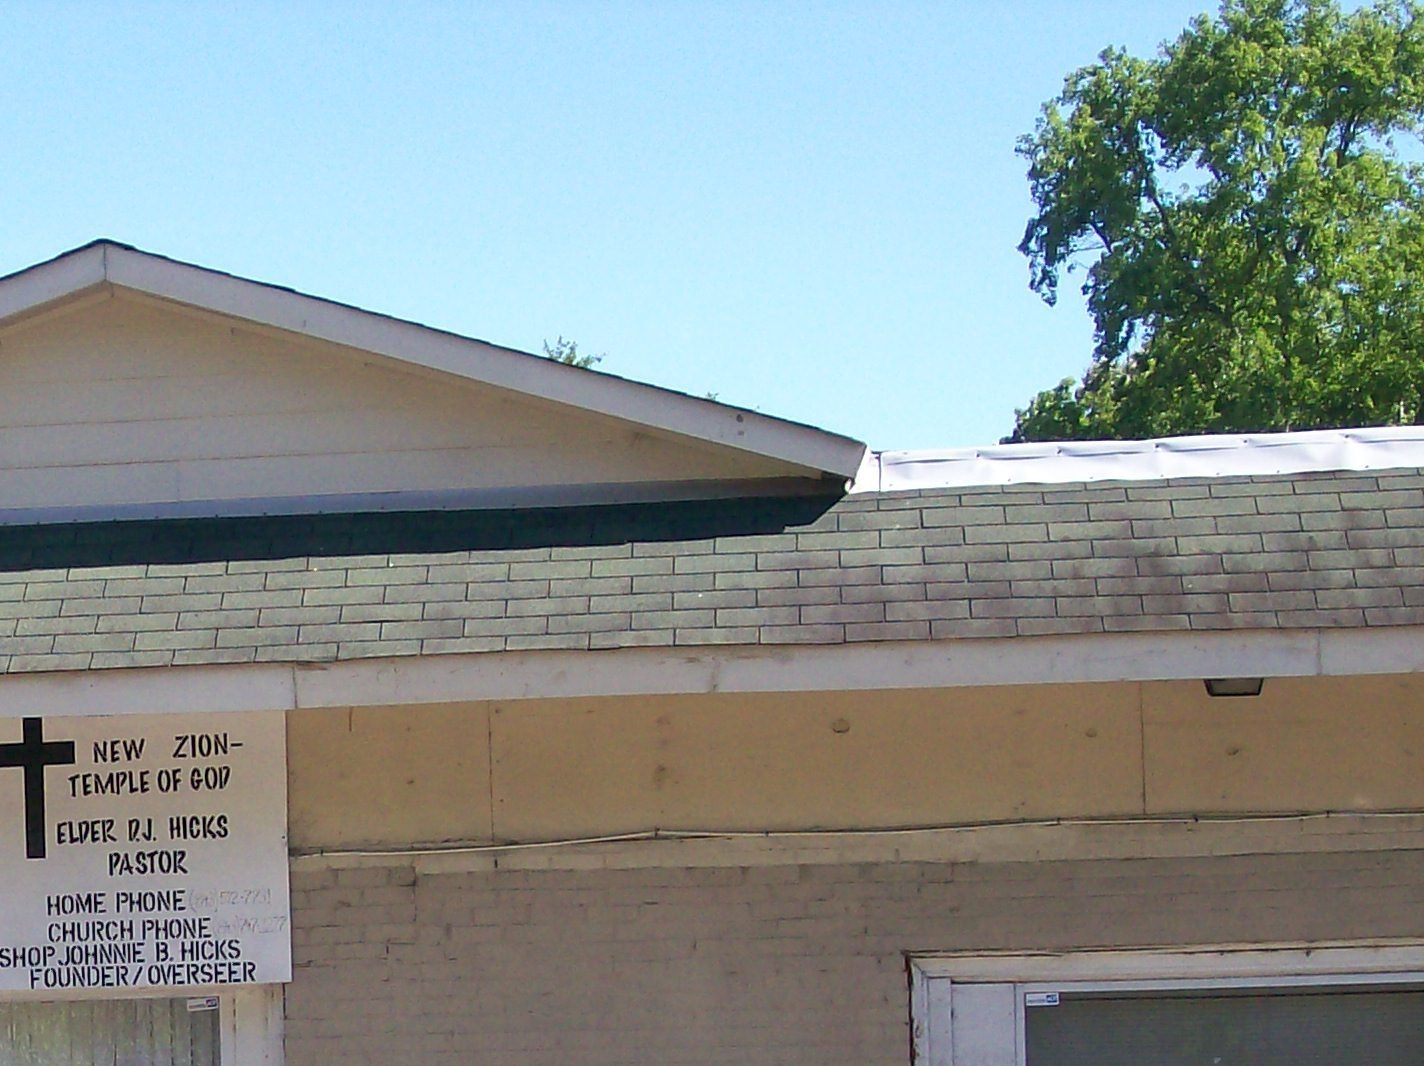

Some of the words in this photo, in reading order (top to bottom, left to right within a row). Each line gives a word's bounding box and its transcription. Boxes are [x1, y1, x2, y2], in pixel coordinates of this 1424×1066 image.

[93, 738, 145, 763] NEW
[68, 770, 150, 797] TEMPLE
[157, 768, 182, 793] OF
[190, 766, 230, 791] GOD
[56, 818, 117, 844] ELDER
[128, 818, 157, 842] D.J.
[169, 814, 228, 840] HICKS
[108, 849, 188, 876] PASTOR
[47, 893, 107, 916] HOME
[116, 890, 186, 913] PHONE
[48, 920, 134, 943] CHURCH
[142, 917, 212, 940] PHONE
[57, 942, 145, 966] JOHNNIE
[181, 939, 241, 961] HICKS
